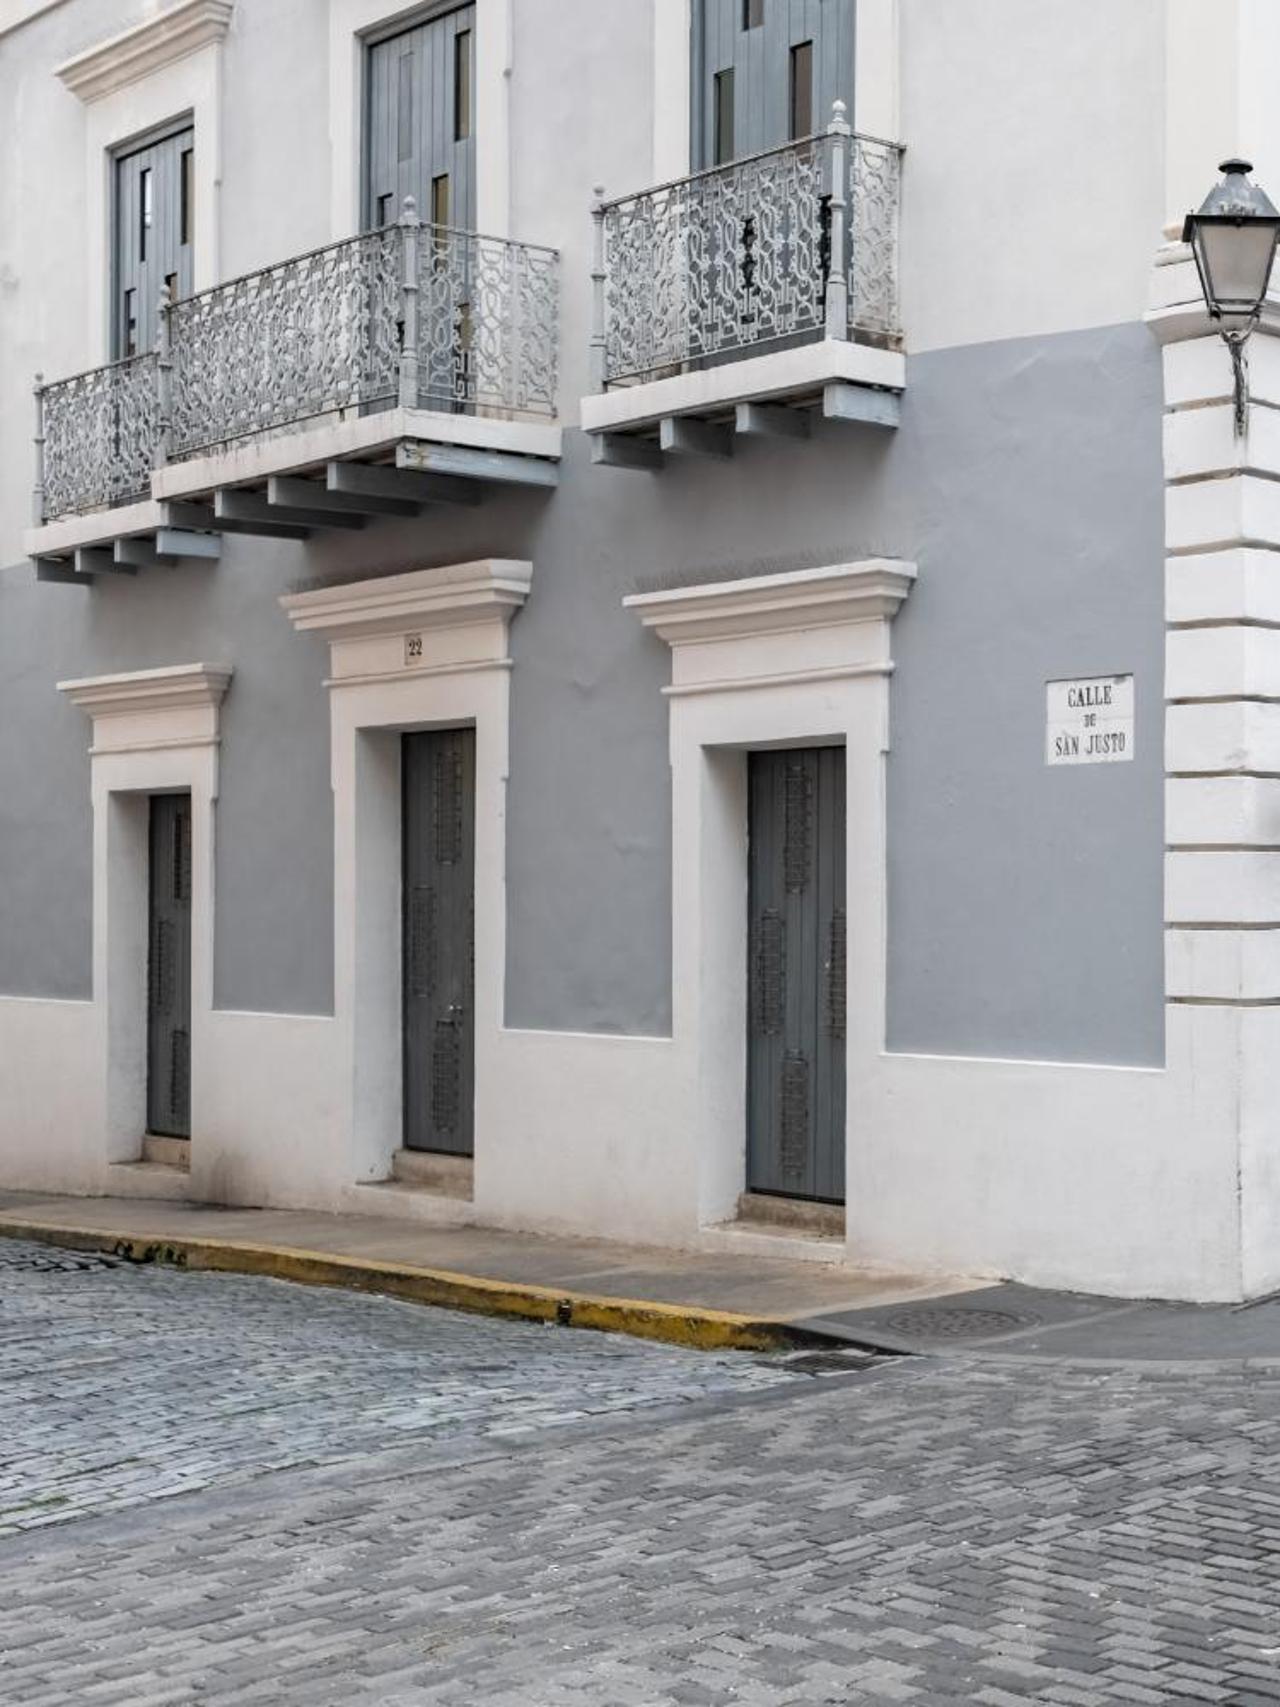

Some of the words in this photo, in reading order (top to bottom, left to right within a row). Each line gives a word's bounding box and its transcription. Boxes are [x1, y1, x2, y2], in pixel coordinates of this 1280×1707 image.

[409, 638, 422, 656] 22
[1068, 685, 1112, 708] CALLE
[1083, 713, 1096, 728] DE
[1055, 736, 1079, 756] SAN
[1085, 732, 1126, 754] JUSTO
